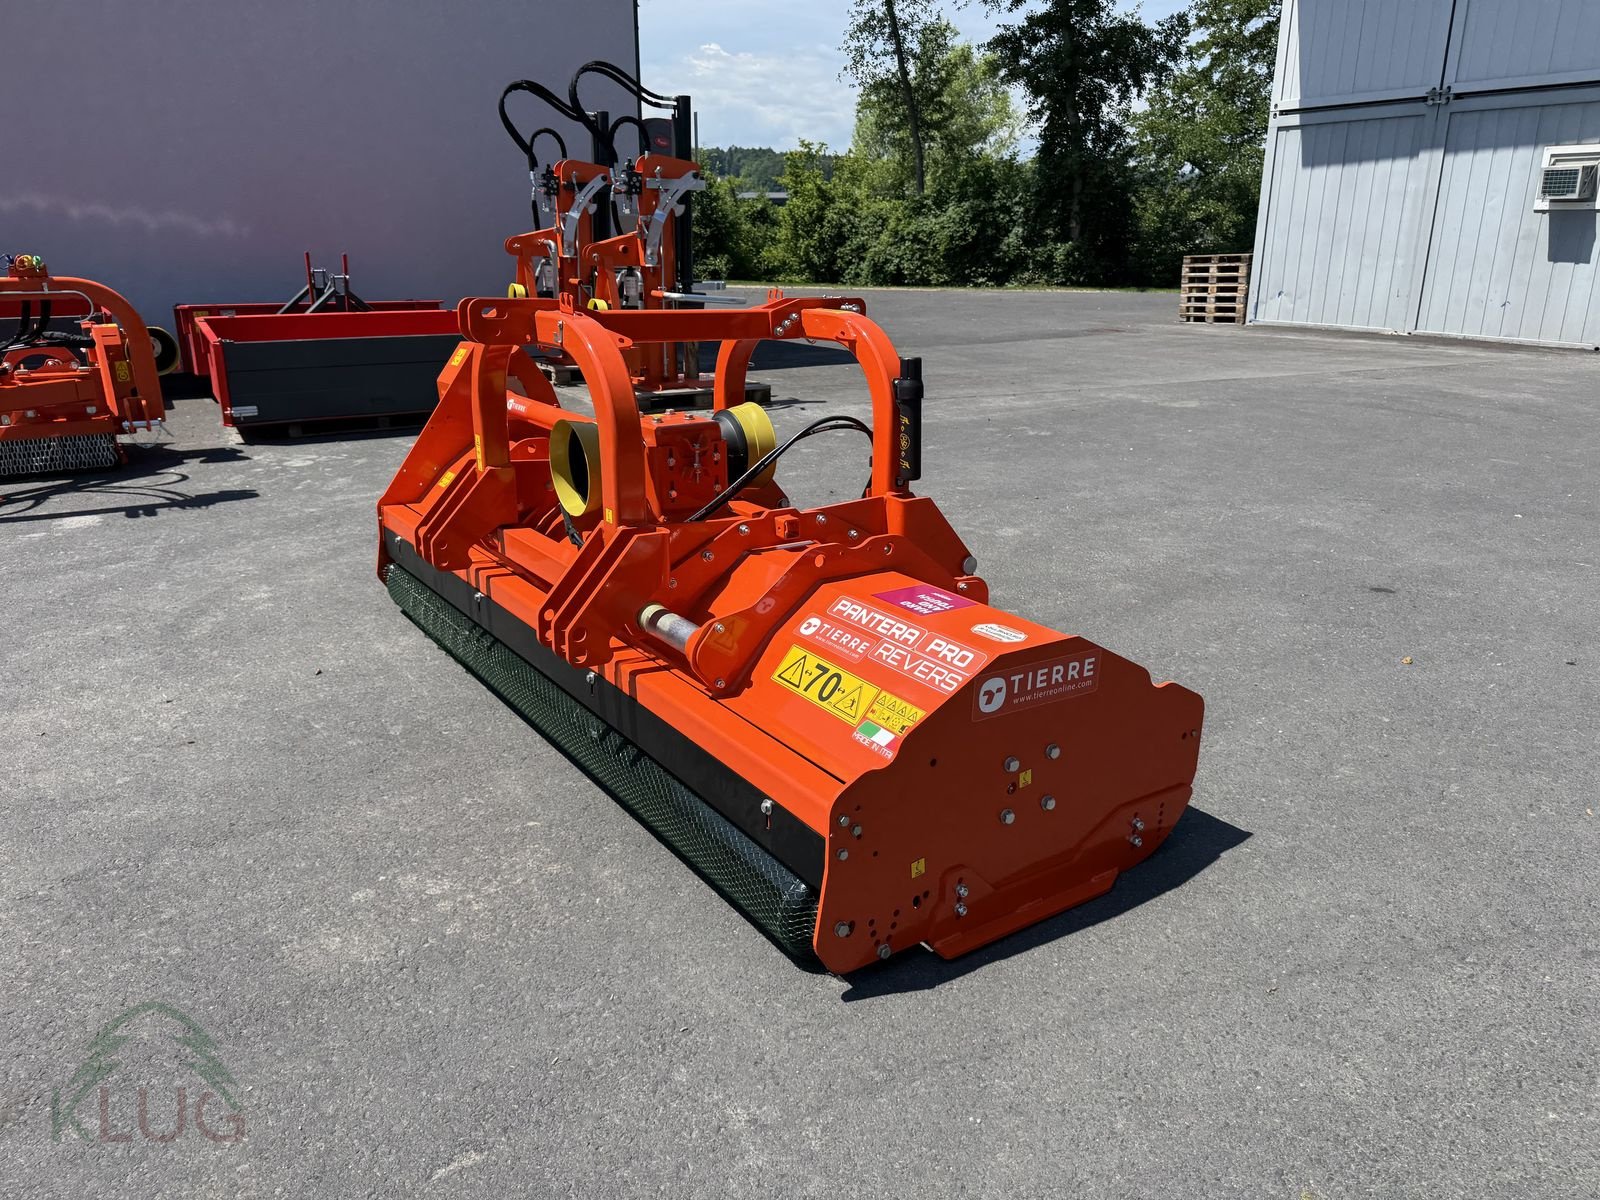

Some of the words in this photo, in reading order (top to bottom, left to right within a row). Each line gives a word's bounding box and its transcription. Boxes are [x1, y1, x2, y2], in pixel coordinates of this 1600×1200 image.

[819, 622, 870, 655] TIERRE
[832, 599, 921, 645] PANTERA
[924, 638, 974, 668] PRO
[803, 663, 843, 702] 70
[874, 642, 962, 692] REVERS
[1010, 657, 1096, 694] TIERRE
[1012, 679, 1093, 705] www.tierreonline.com
[851, 731, 873, 747] MADE
